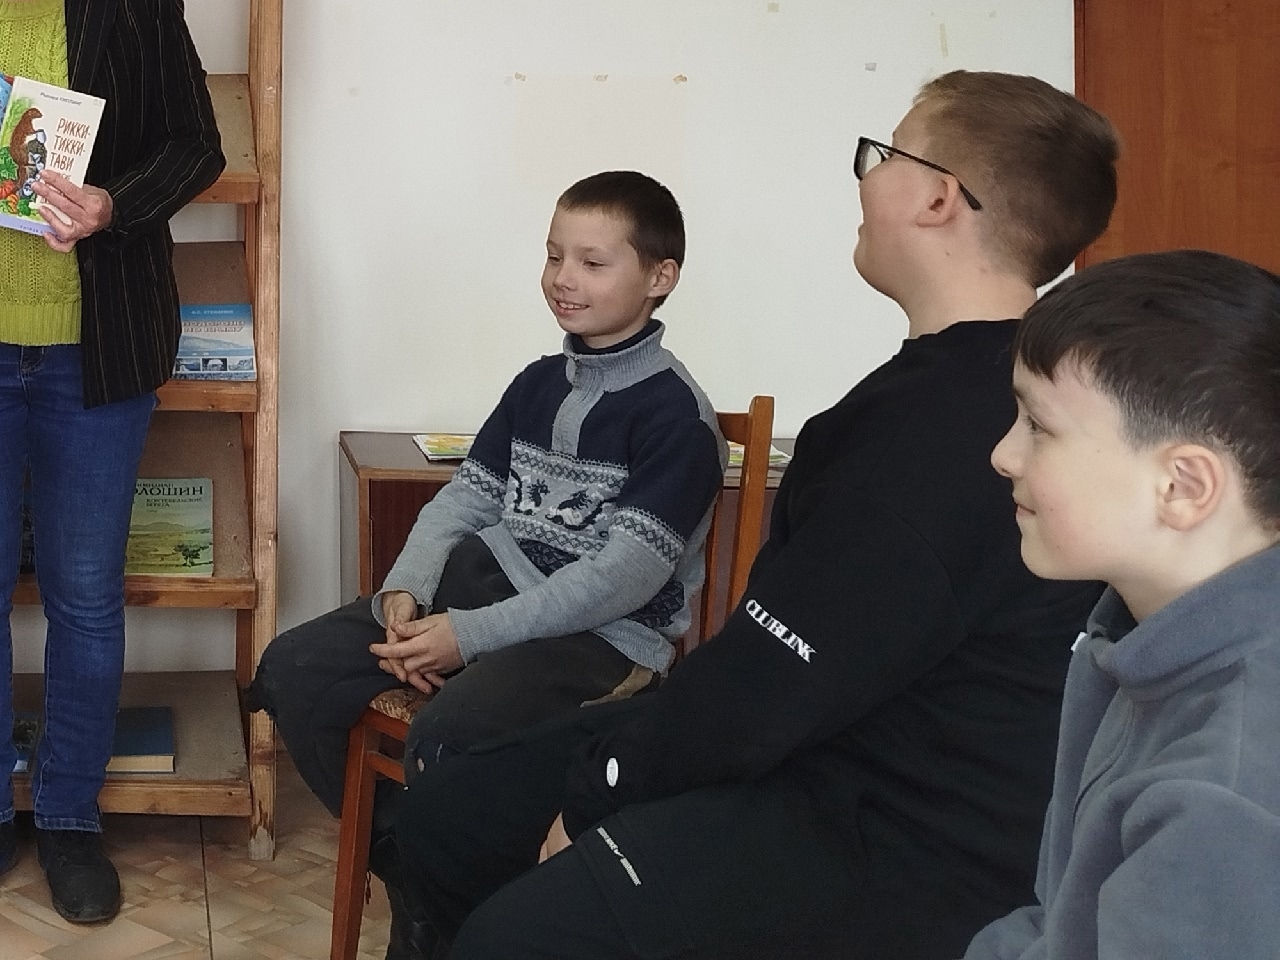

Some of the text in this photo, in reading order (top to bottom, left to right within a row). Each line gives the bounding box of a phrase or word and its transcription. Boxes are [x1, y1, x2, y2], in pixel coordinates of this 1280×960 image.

[56, 118, 91, 139] РИККИ-
[53, 135, 87, 156] ТИККИ-
[49, 152, 75, 172] ТАВИ
[135, 486, 204, 496] ЛОШИН
